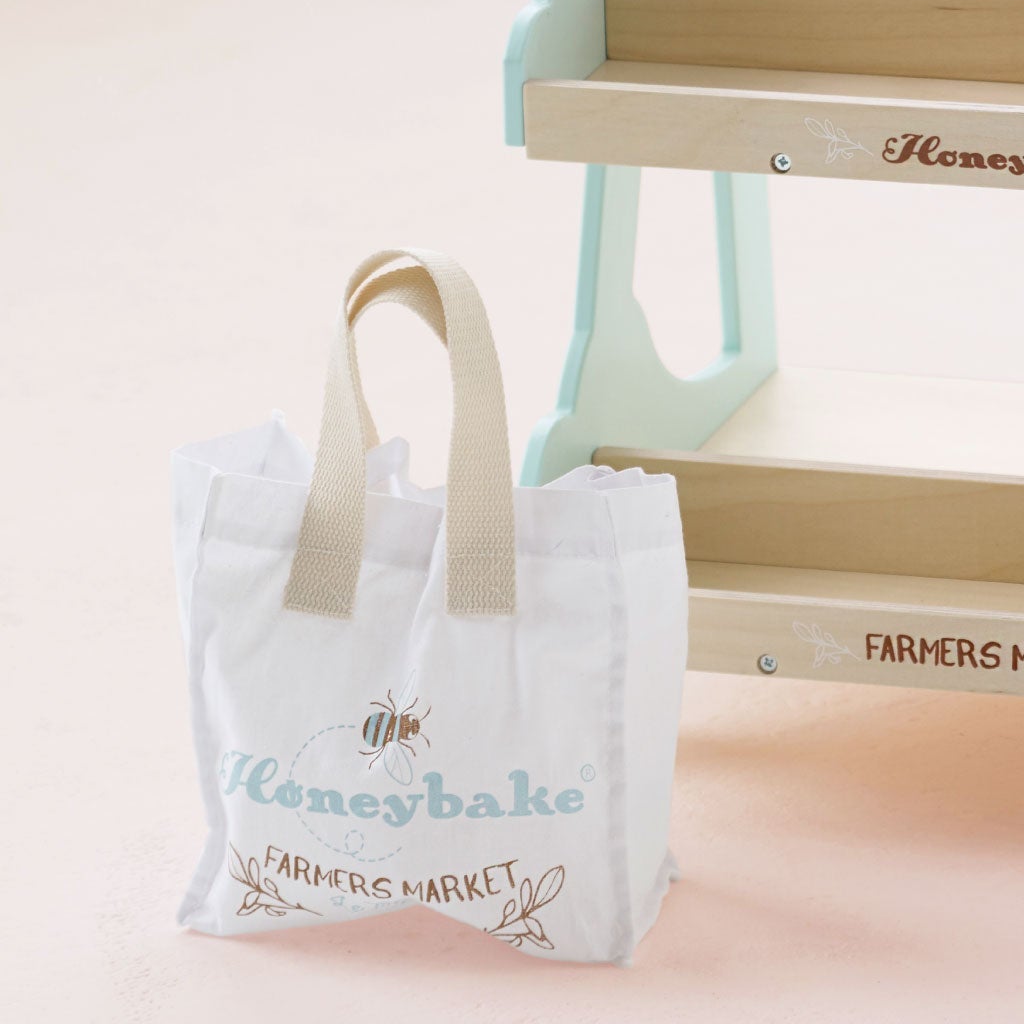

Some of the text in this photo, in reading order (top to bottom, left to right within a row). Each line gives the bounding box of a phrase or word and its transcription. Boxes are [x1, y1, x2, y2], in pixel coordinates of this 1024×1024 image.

[866, 633, 1001, 669] FARMERS
[264, 845, 519, 903] FARMERS MARKET
